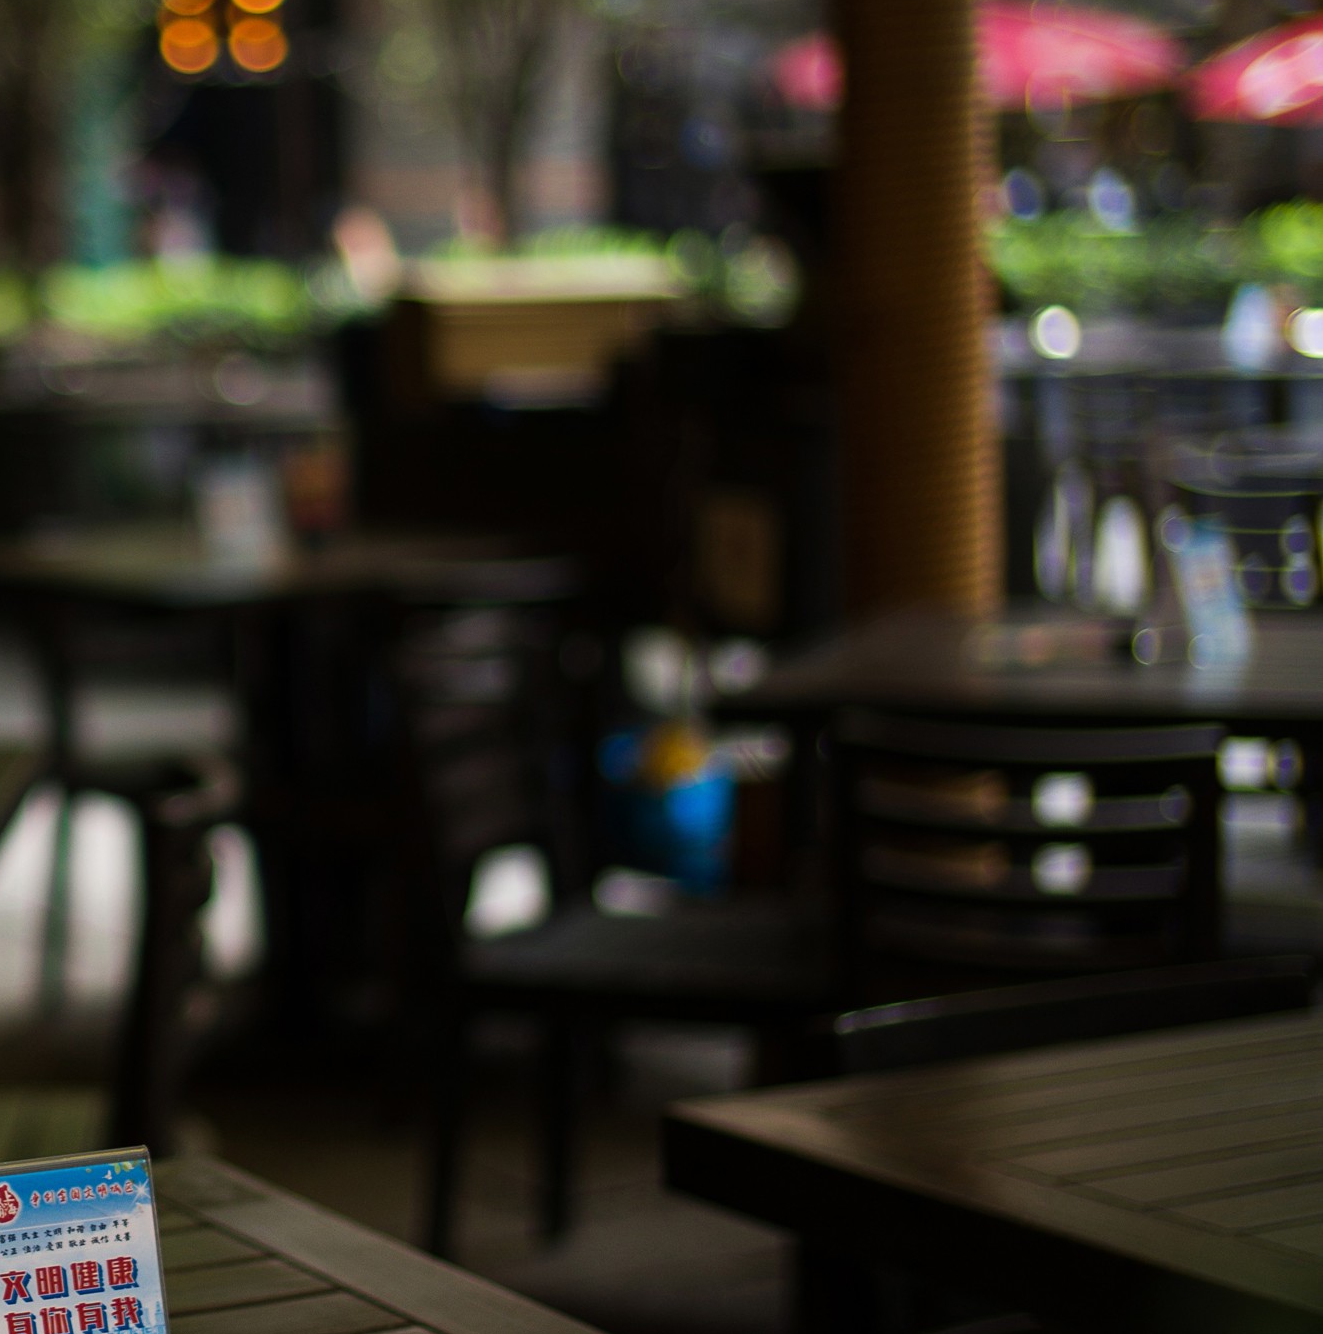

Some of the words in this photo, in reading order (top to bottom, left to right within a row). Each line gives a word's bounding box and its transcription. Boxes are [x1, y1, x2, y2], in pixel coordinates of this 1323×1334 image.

[30, 1179, 134, 1207] 争创全国文明城区
[43, 1227, 63, 1238] 文明
